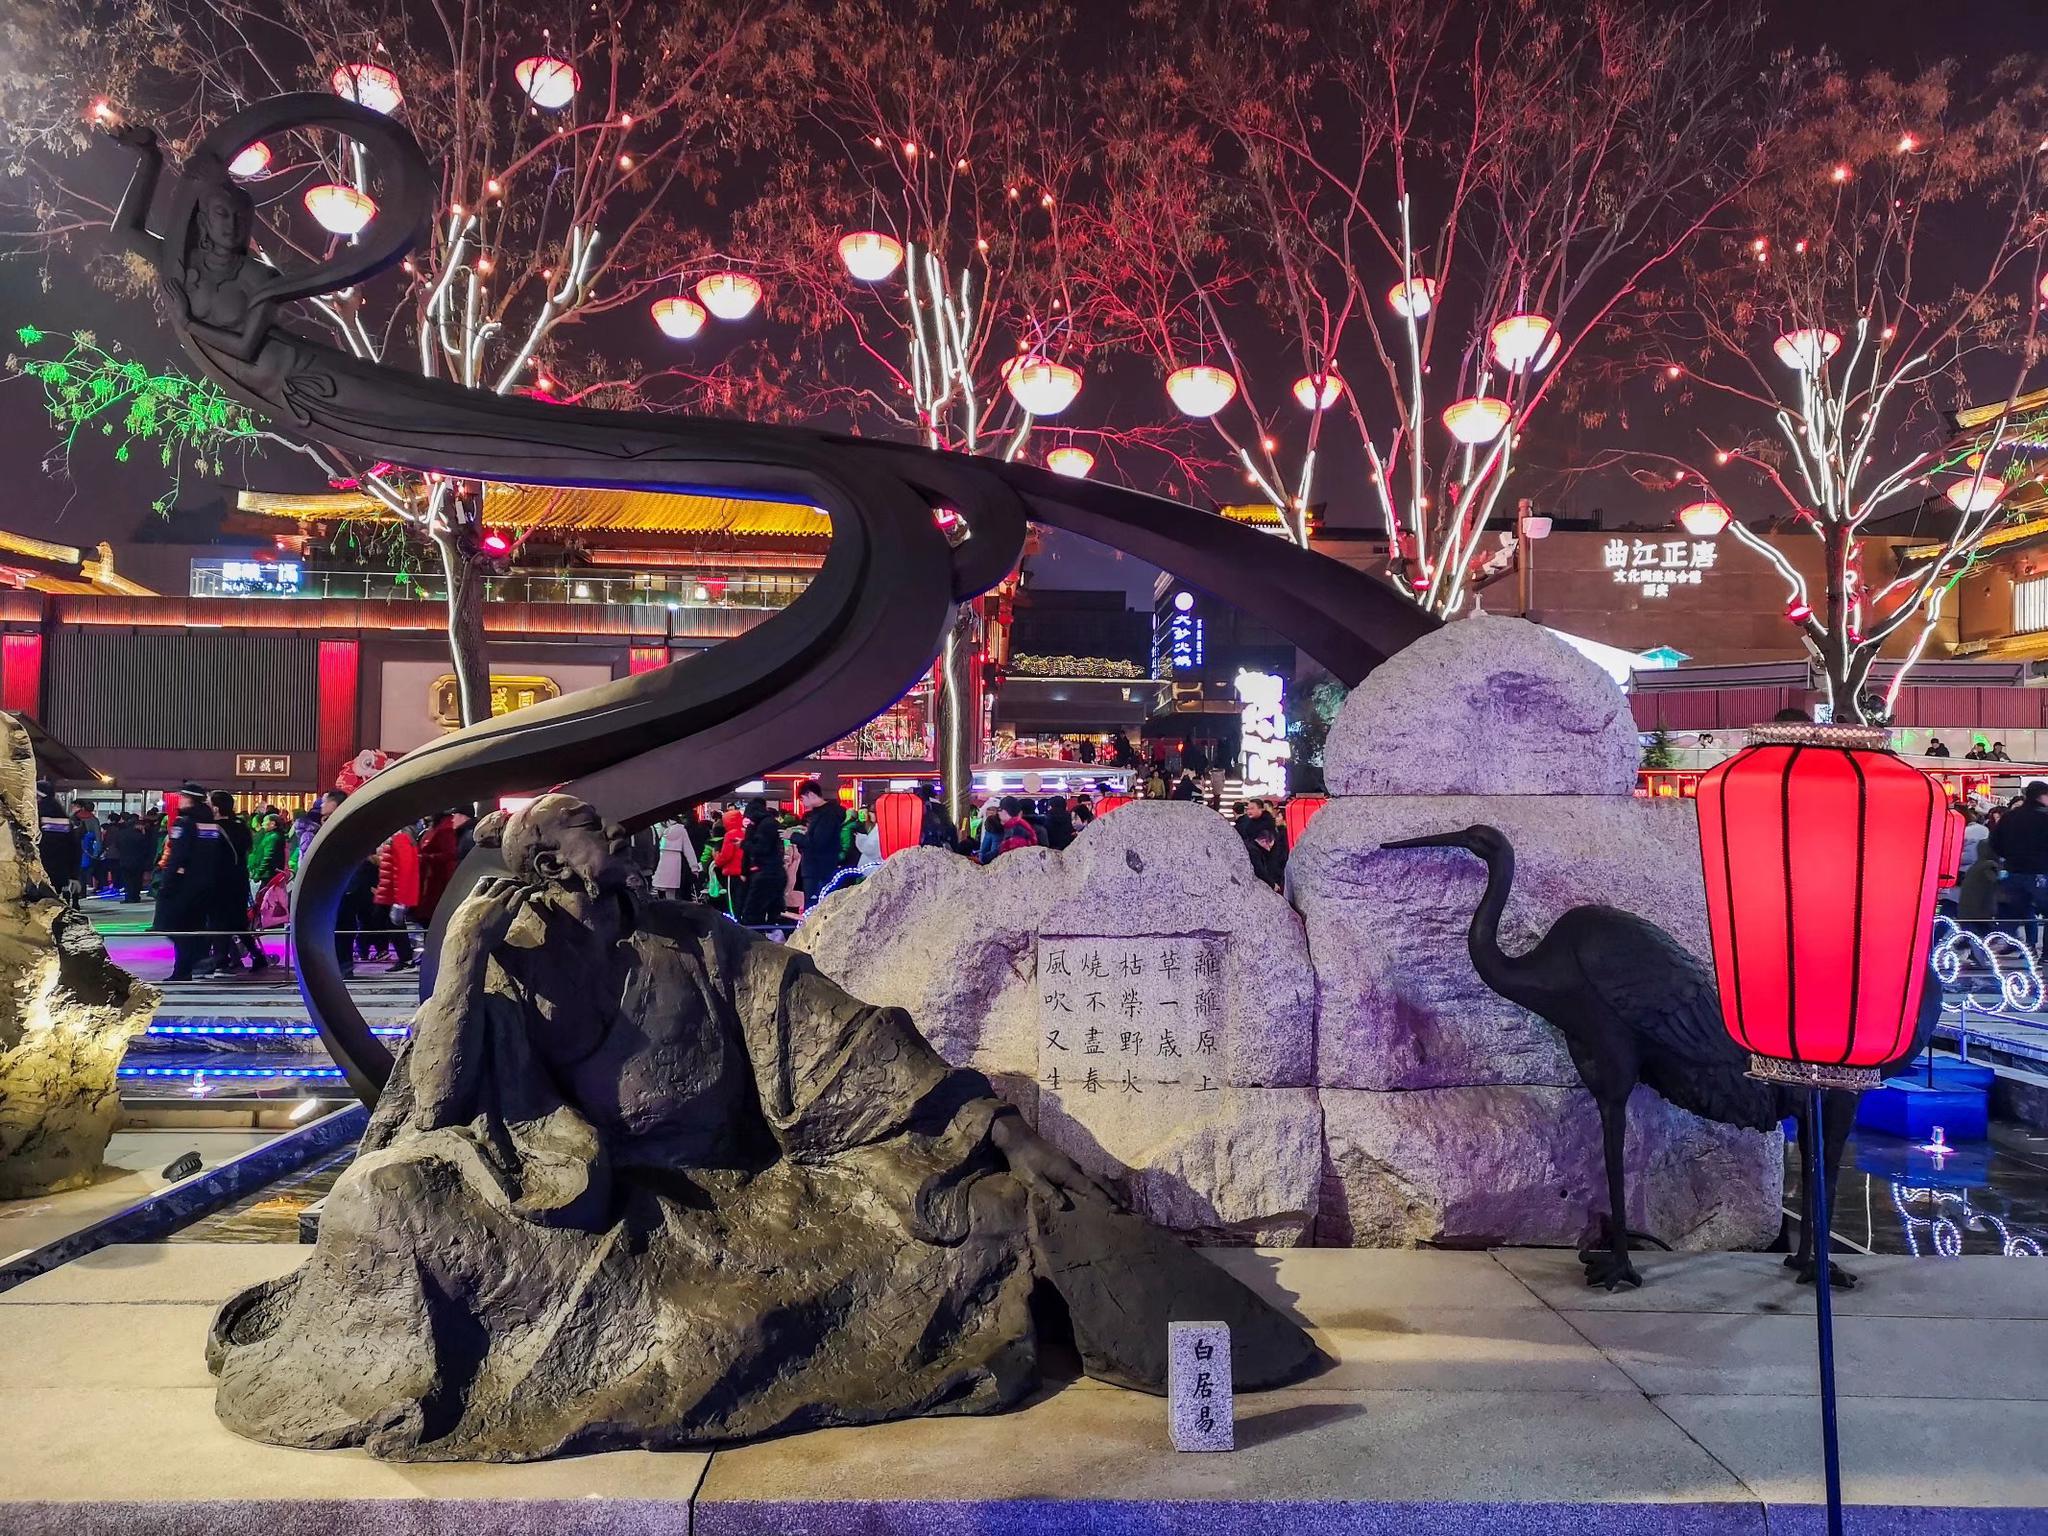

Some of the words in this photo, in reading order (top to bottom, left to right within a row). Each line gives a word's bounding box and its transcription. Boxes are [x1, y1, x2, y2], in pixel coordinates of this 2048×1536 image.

[1604, 538, 1718, 568] 曲江正唐
[1193, 1338, 1215, 1434] 白居易
